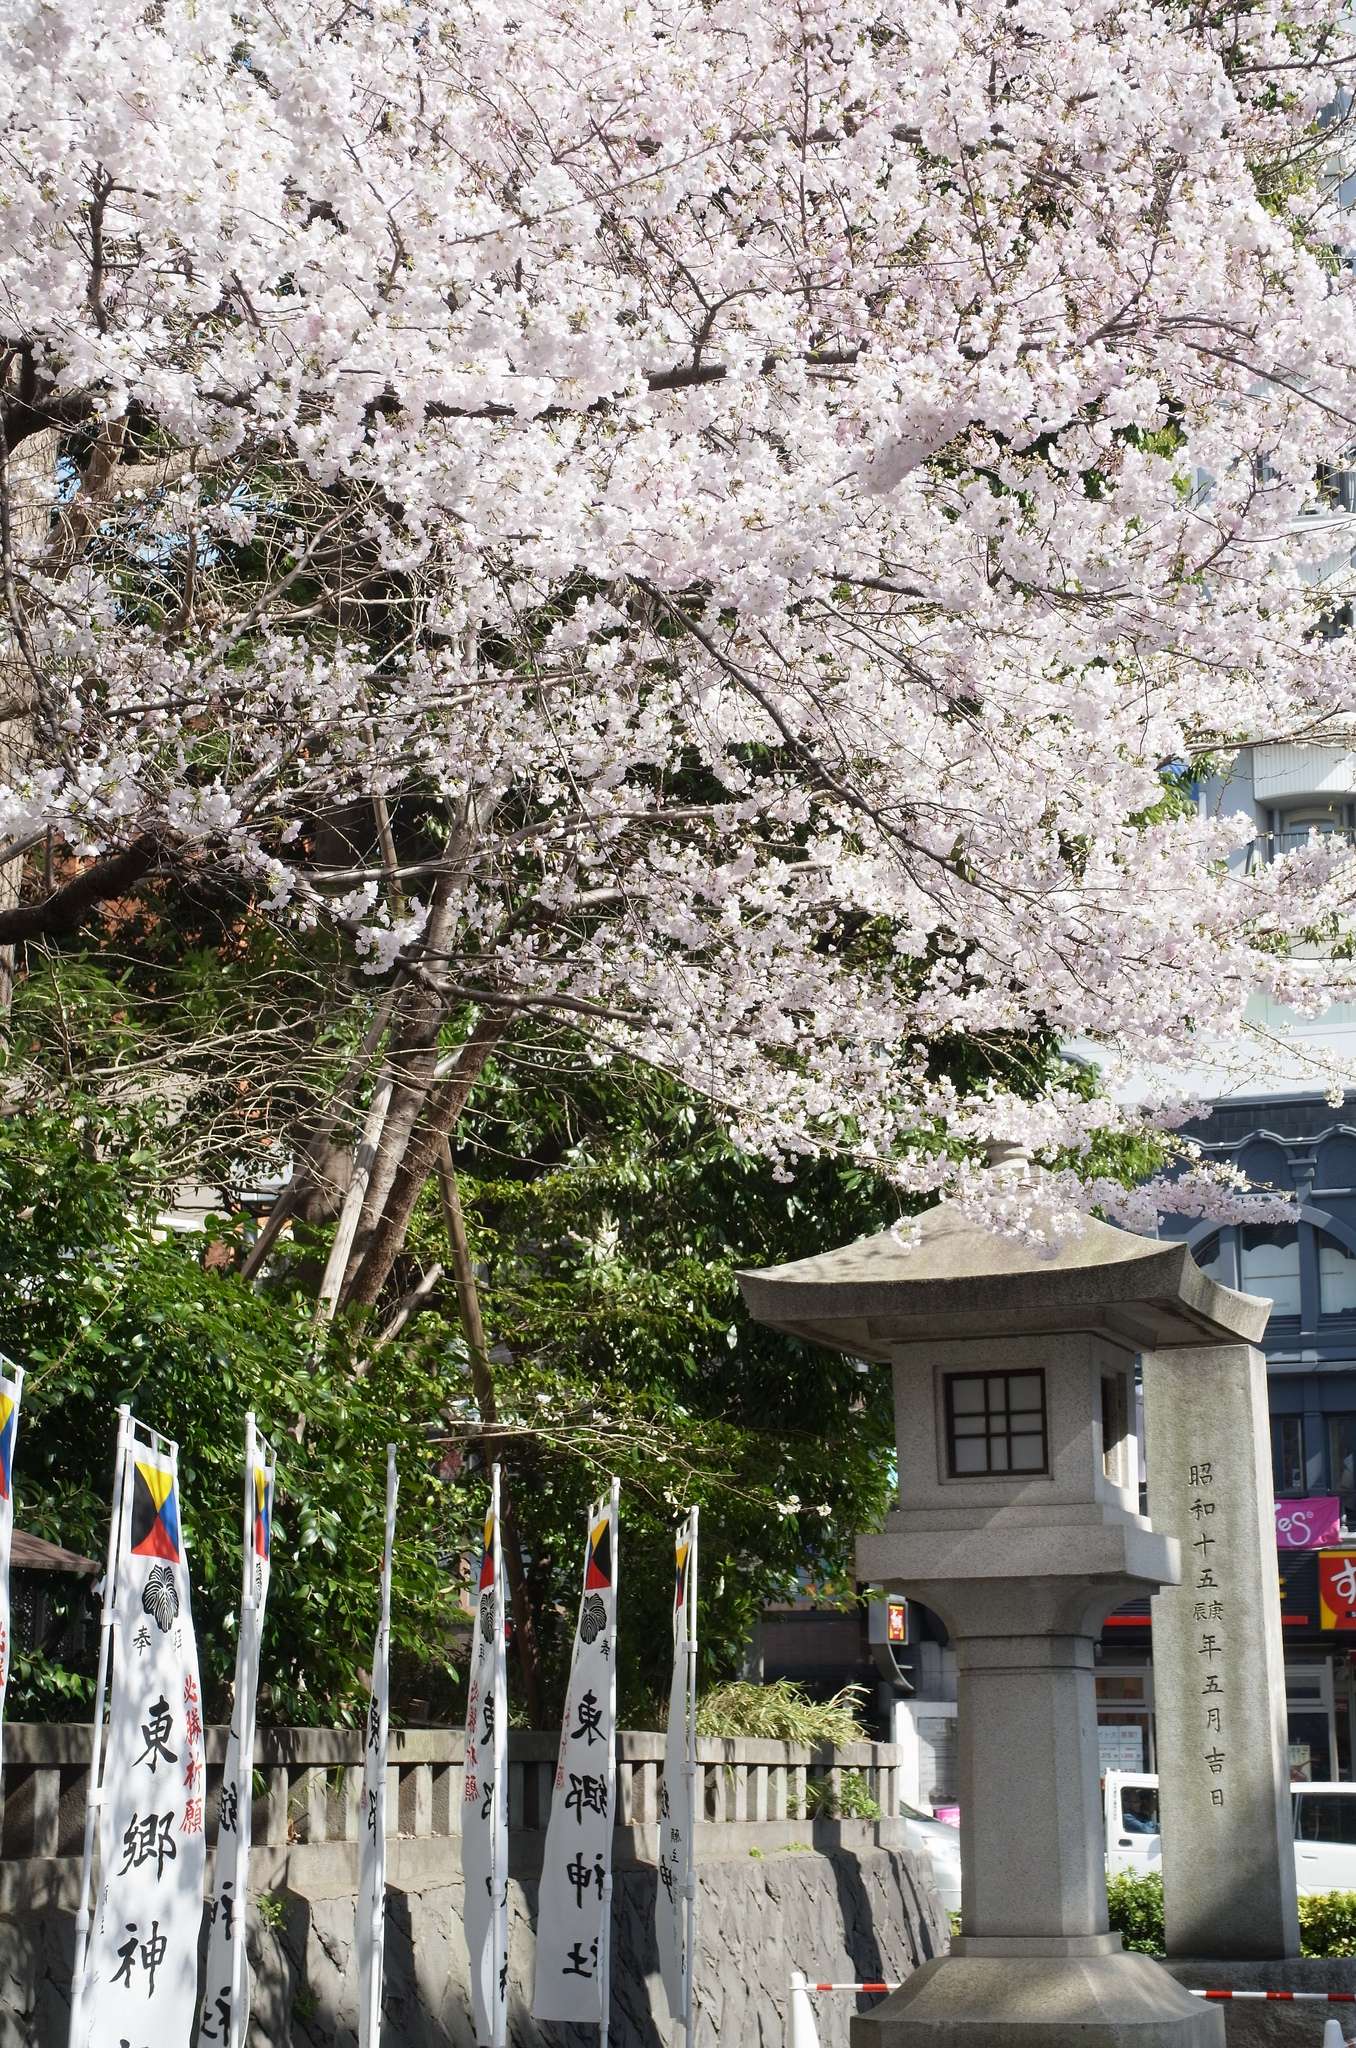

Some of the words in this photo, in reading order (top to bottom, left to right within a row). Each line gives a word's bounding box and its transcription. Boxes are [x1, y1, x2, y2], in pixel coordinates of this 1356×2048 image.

[109, 1695, 178, 2048] 東郷神
[178, 1674, 203, 1834] 必勝祈願
